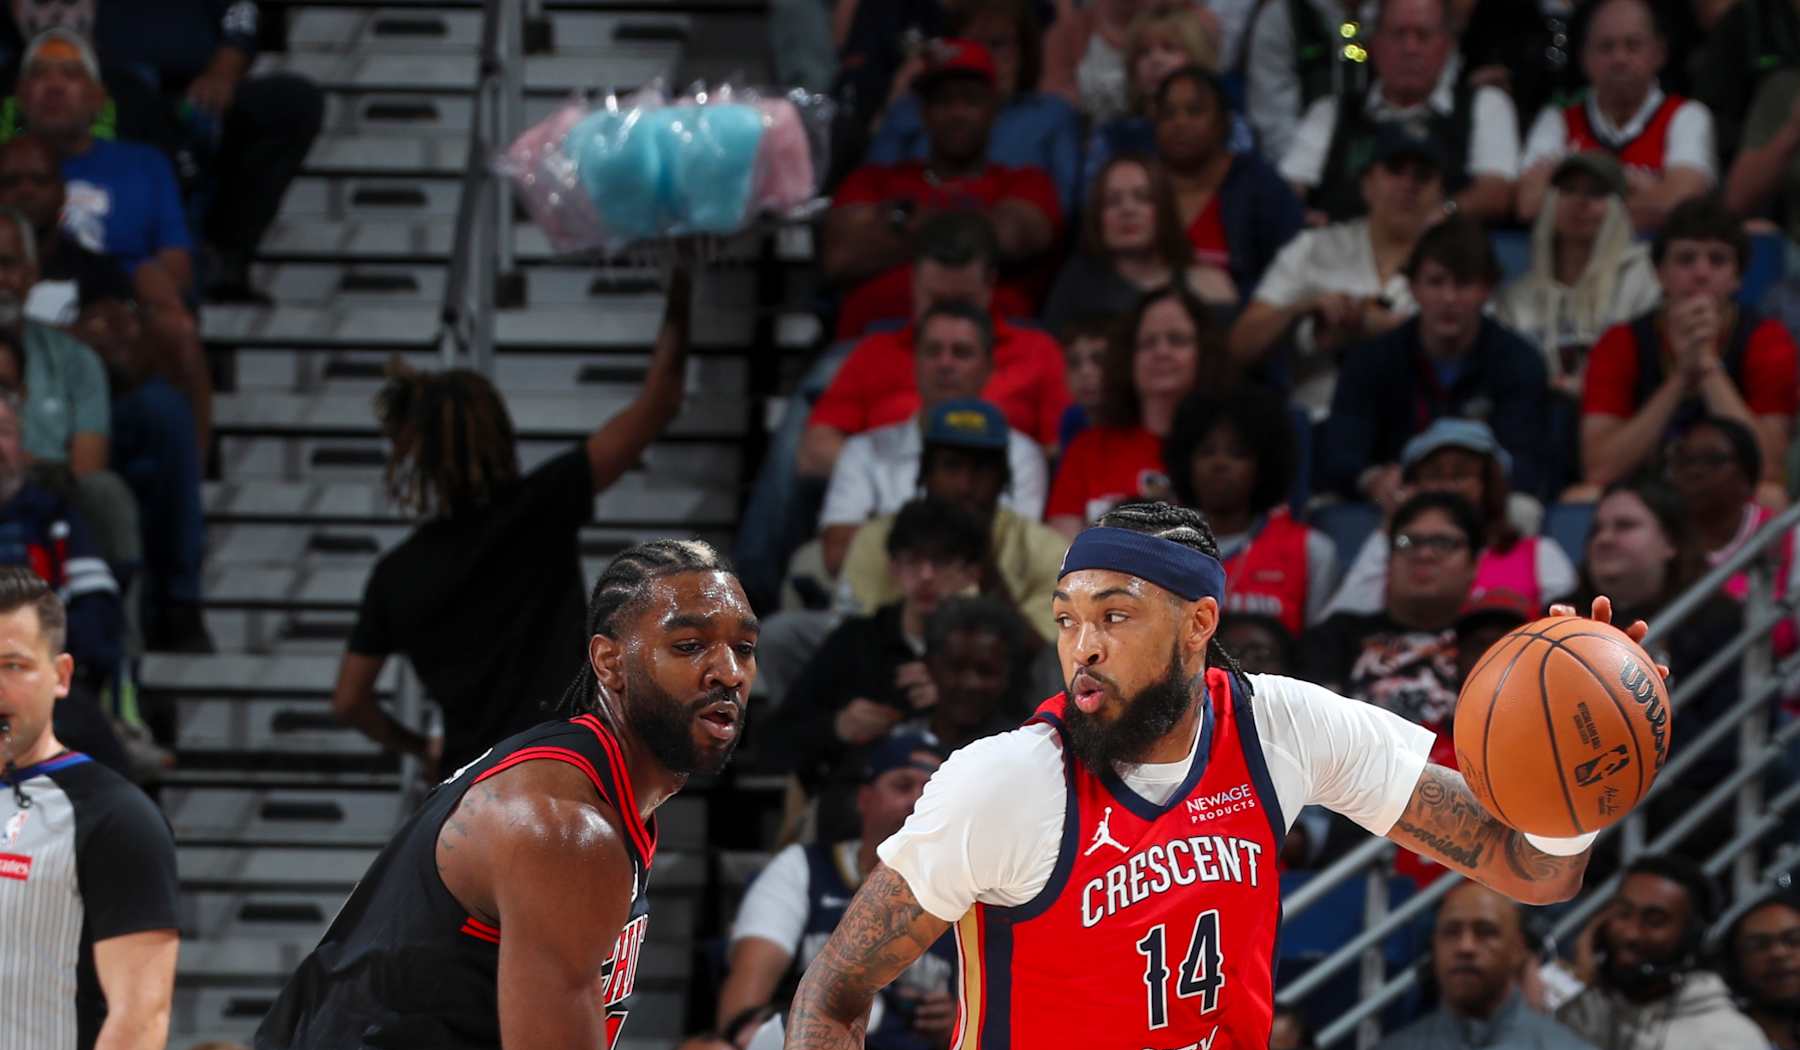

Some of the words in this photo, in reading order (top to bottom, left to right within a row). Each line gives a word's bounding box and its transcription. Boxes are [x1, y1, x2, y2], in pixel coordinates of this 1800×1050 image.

[1186, 783, 1252, 814] NEWAGE
[1191, 799, 1256, 824] PRODUCTS
[1081, 835, 1263, 929] CRESCENT
[1136, 908, 1226, 1031] 14
